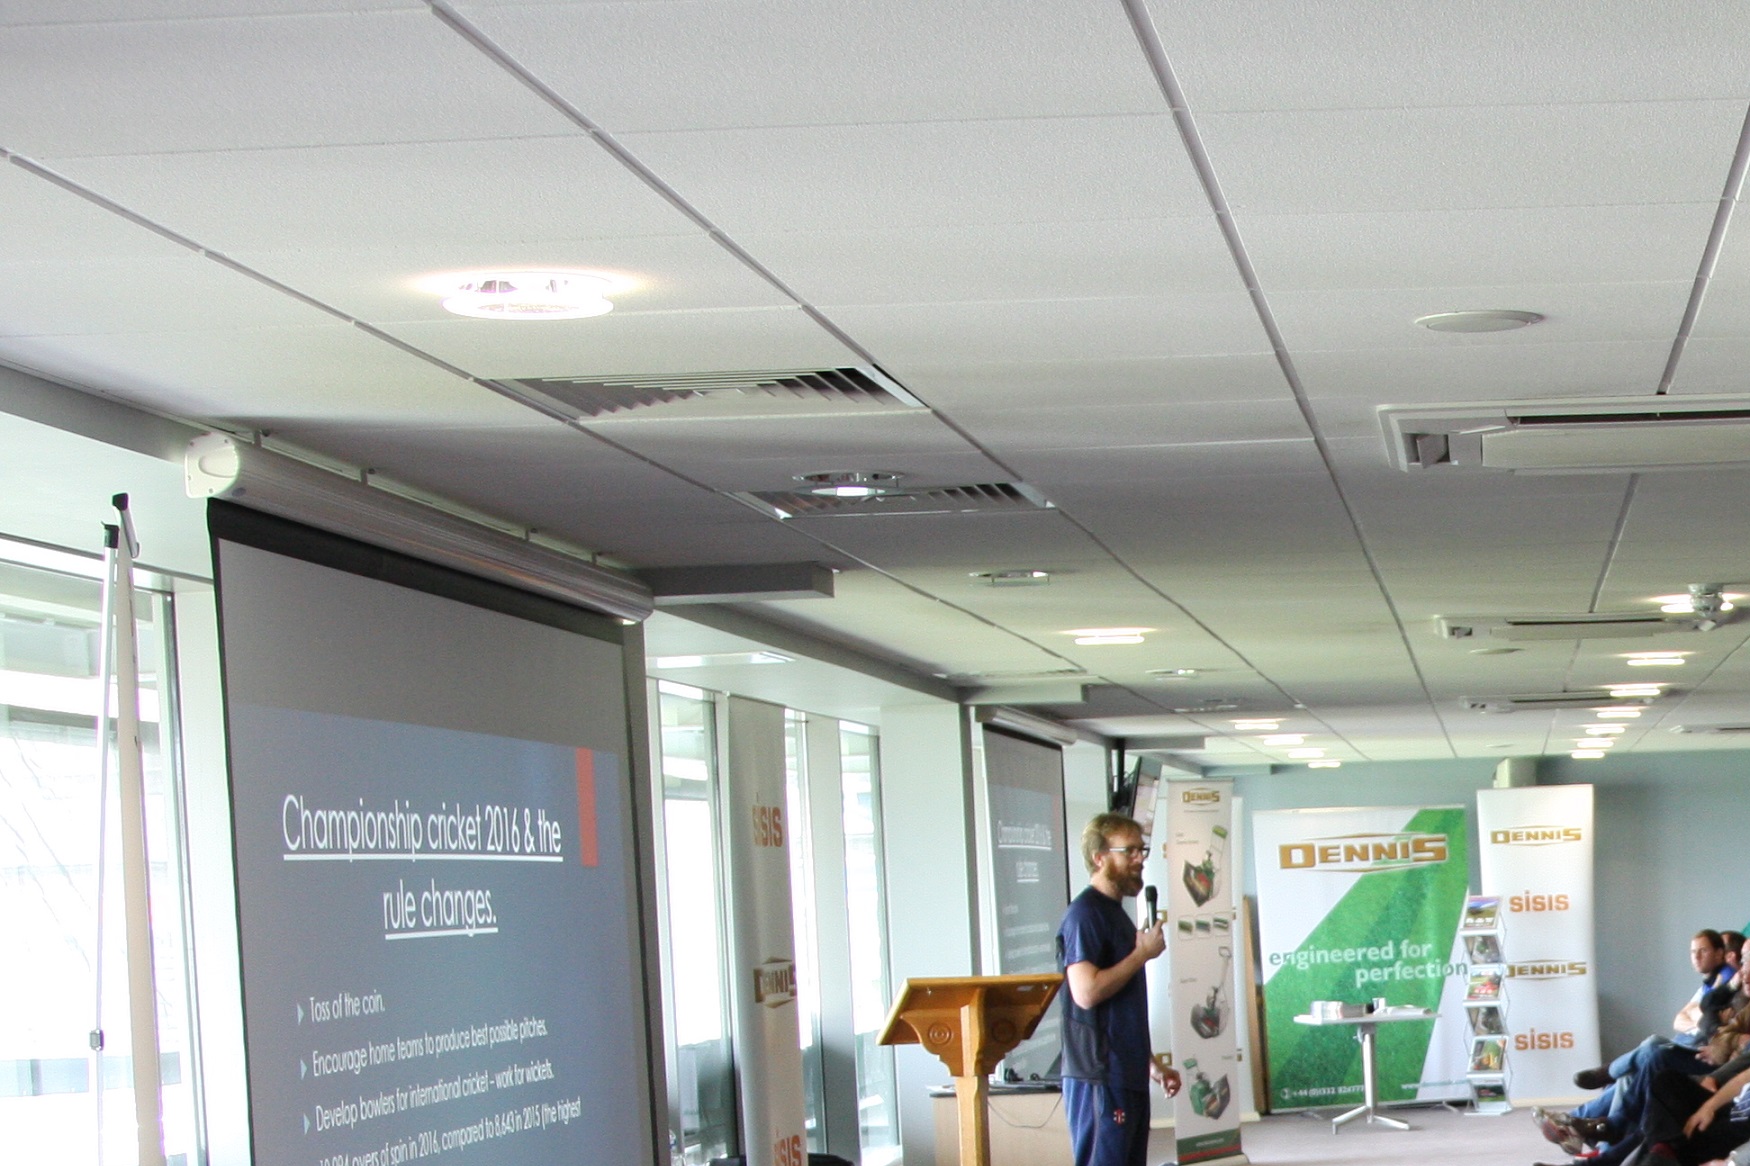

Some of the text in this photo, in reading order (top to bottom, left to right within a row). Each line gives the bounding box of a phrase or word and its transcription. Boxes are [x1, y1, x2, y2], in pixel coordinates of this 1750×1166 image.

[282, 794, 562, 862] Championship cricket 2016 & the
[1490, 828, 1582, 844] DENNIS
[1279, 837, 1447, 869] DENNIS
[383, 878, 498, 937] rule changes.
[1269, 939, 1433, 970] engineered for
[1355, 959, 1468, 988] perfection
[310, 990, 385, 1022] Toss of the coin.
[313, 1017, 547, 1077] Encourage home teams to produce best possible pitches.
[316, 1101, 357, 1131] Develop
[360, 1092, 394, 1120] bowlers
[397, 1086, 408, 1110] for
[410, 1076, 460, 1107] international
[462, 1070, 488, 1096] cricket
[495, 1066, 512, 1088] work
[514, 1064, 524, 1085] for
[526, 1059, 554, 1082] wickets.
[381, 1143, 389, 1166] of
[442, 1119, 484, 1150] compared
[486, 1115, 494, 1138] to
[523, 1105, 540, 1129] 2015
[557, 1096, 581, 1125] highest
